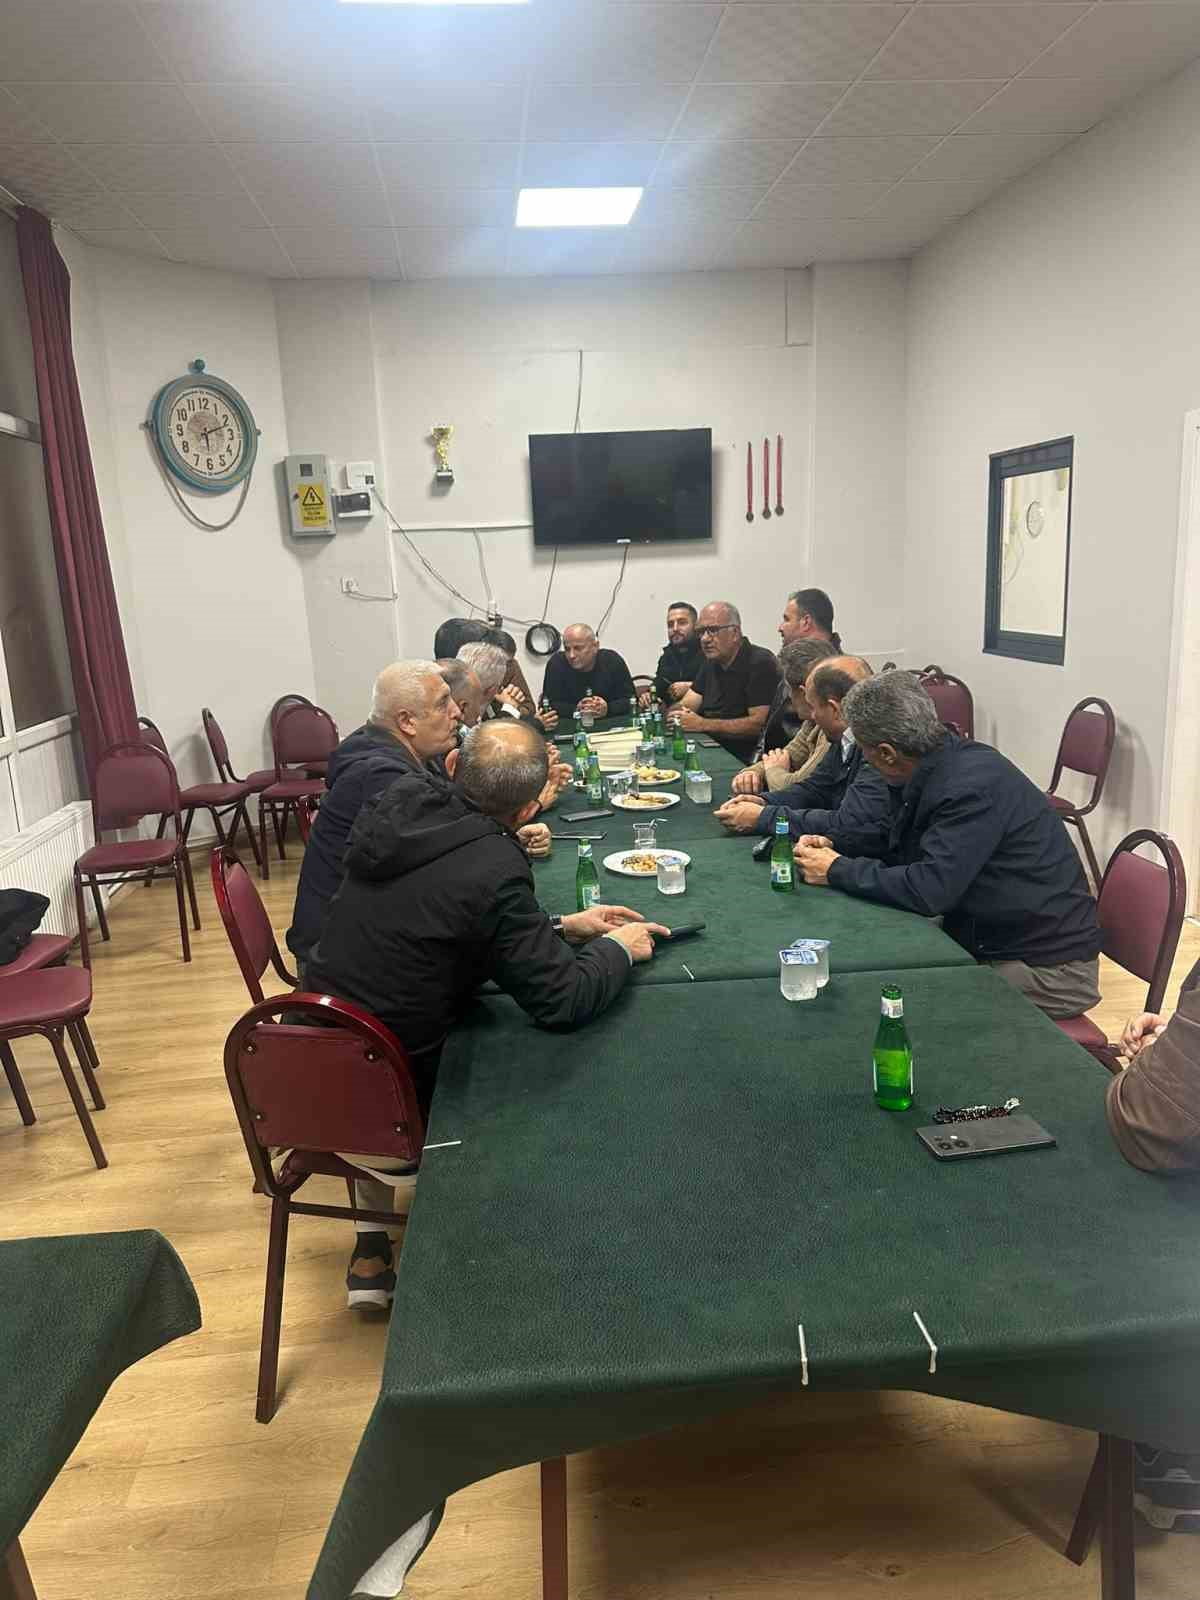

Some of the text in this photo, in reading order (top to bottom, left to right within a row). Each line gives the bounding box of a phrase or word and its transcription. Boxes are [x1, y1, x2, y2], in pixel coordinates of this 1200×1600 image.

[188, 400, 195, 412] 11
[198, 398, 210, 410] 12
[214, 403, 218, 415] 1
[177, 408, 188, 421] 10
[222, 414, 230, 426] 2
[176, 424, 184, 436] 9
[227, 428, 234, 440] 3
[182, 440, 189, 453] 8
[226, 444, 232, 456] 4
[193, 454, 200, 466] 7
[206, 458, 214, 470] 6
[219, 454, 226, 466] 5
